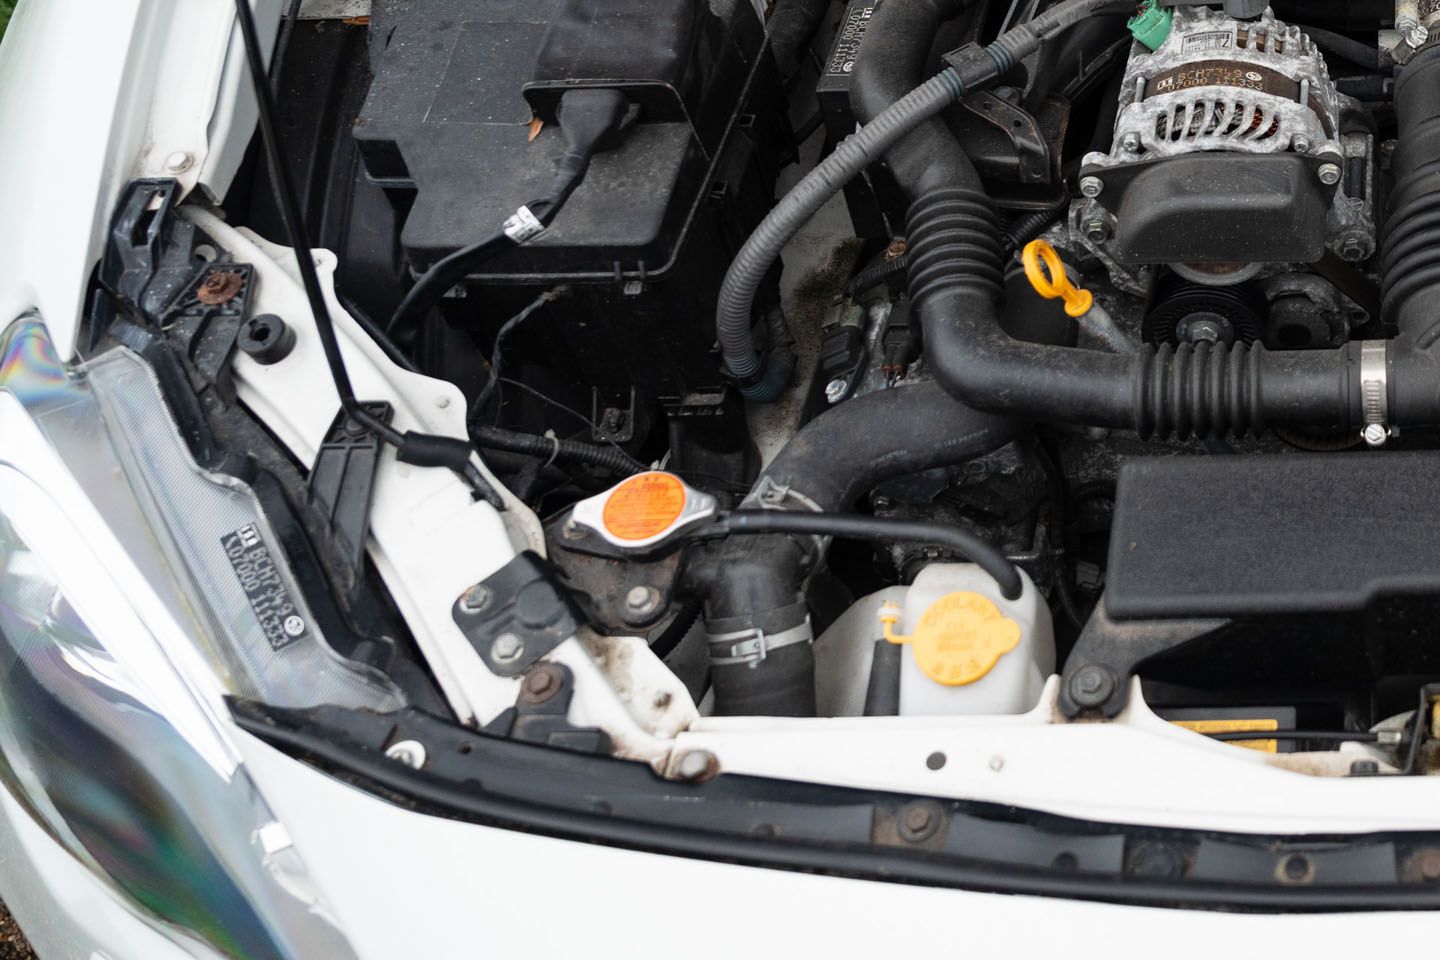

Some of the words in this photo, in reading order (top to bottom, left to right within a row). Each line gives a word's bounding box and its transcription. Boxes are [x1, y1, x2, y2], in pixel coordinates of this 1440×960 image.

[842, 14, 862, 41] 07000
[830, 43, 850, 73] 111333
[1167, 76, 1208, 92] 07000
[1215, 75, 1264, 91] 111333
[1176, 64, 1243, 81] BCH7349
[228, 545, 261, 592] 07000
[250, 593, 290, 647] 111333
